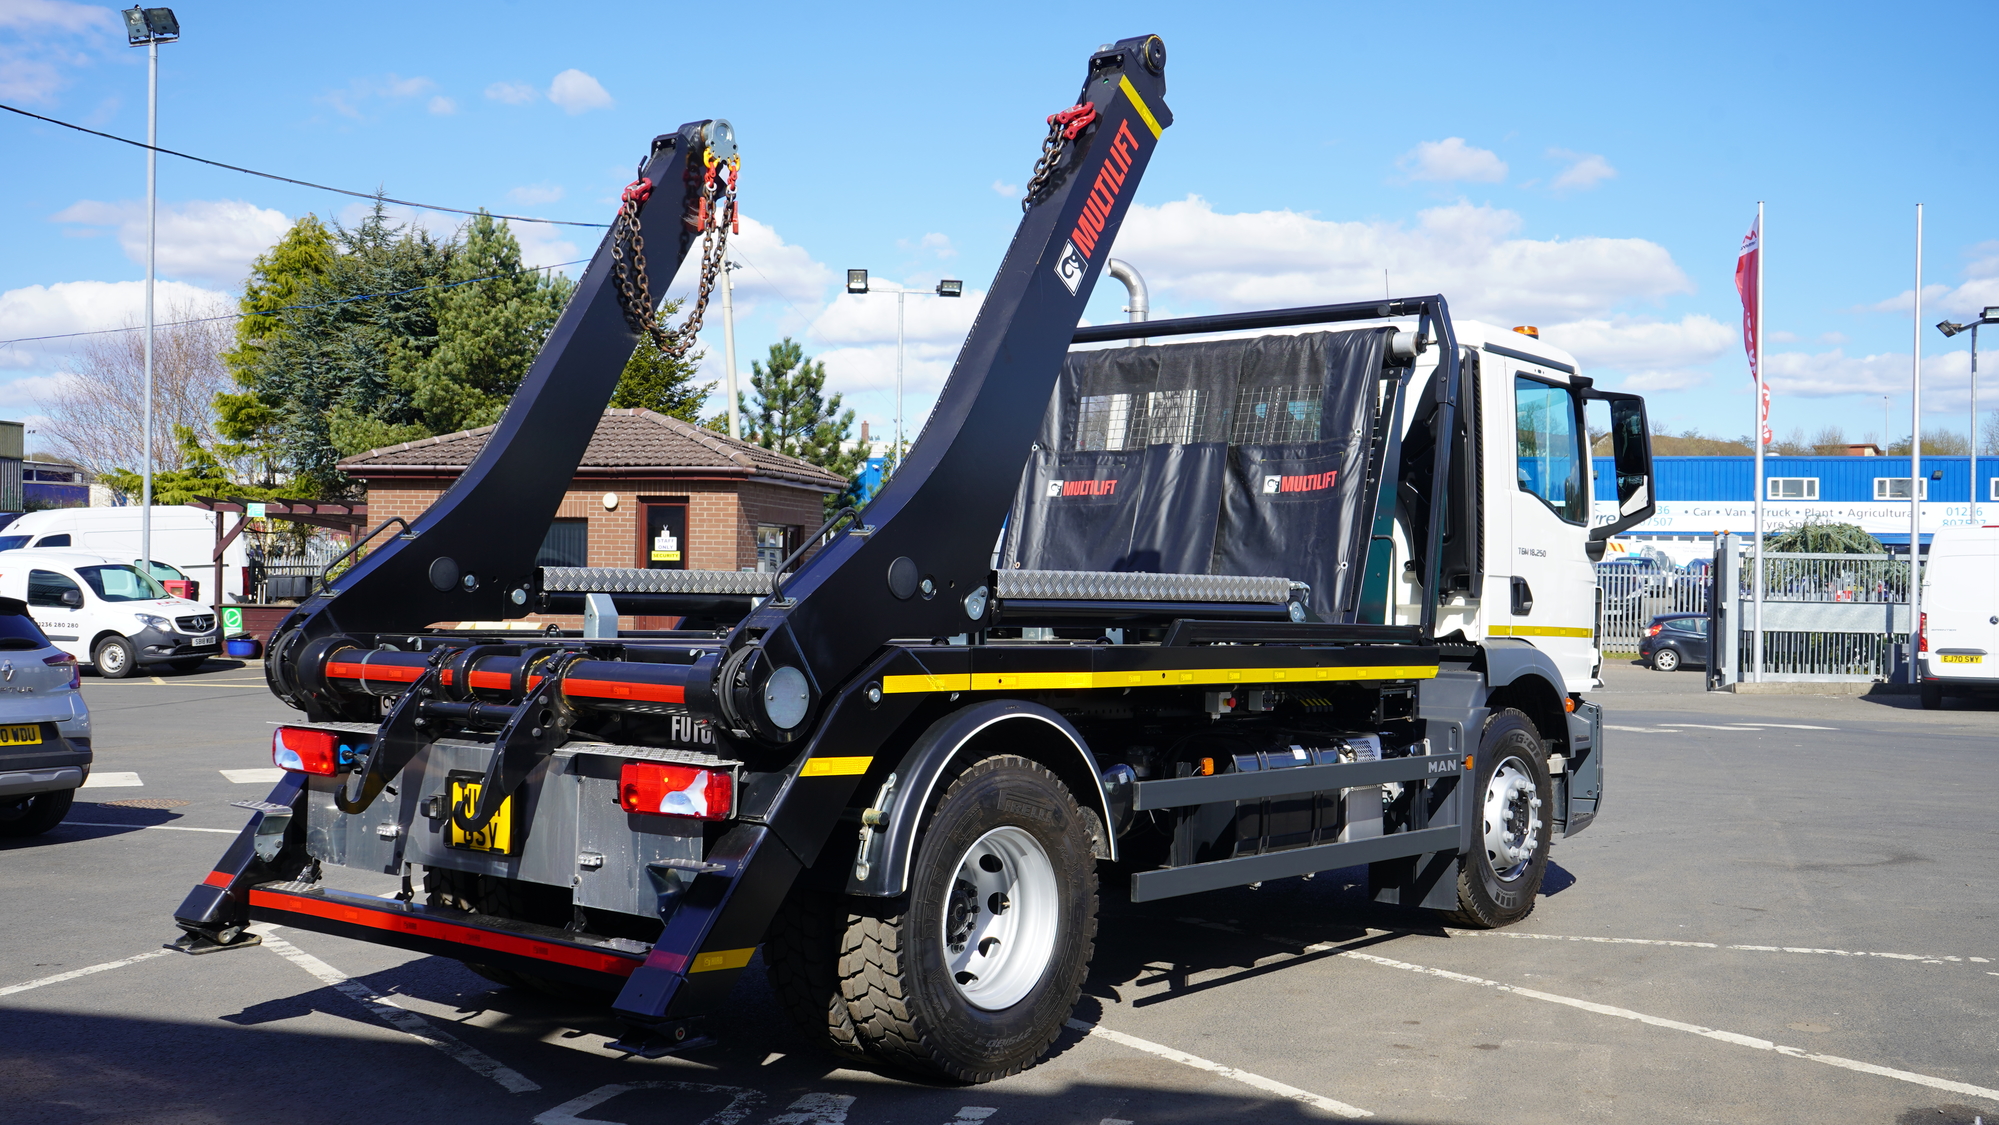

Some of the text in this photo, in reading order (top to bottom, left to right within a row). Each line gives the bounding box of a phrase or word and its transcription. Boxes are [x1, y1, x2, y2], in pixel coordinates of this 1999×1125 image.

[1071, 118, 1139, 259] MULTILIFT
[1063, 480, 1118, 496] MULTILIFT
[1280, 471, 1337, 492] MULTILIFT
[1693, 507, 1912, 519] Car Van Truck Plant Agricultura
[1946, 506, 1983, 516] 0126
[11, 727, 36, 742] WDU
[1428, 759, 1457, 773] MAN
